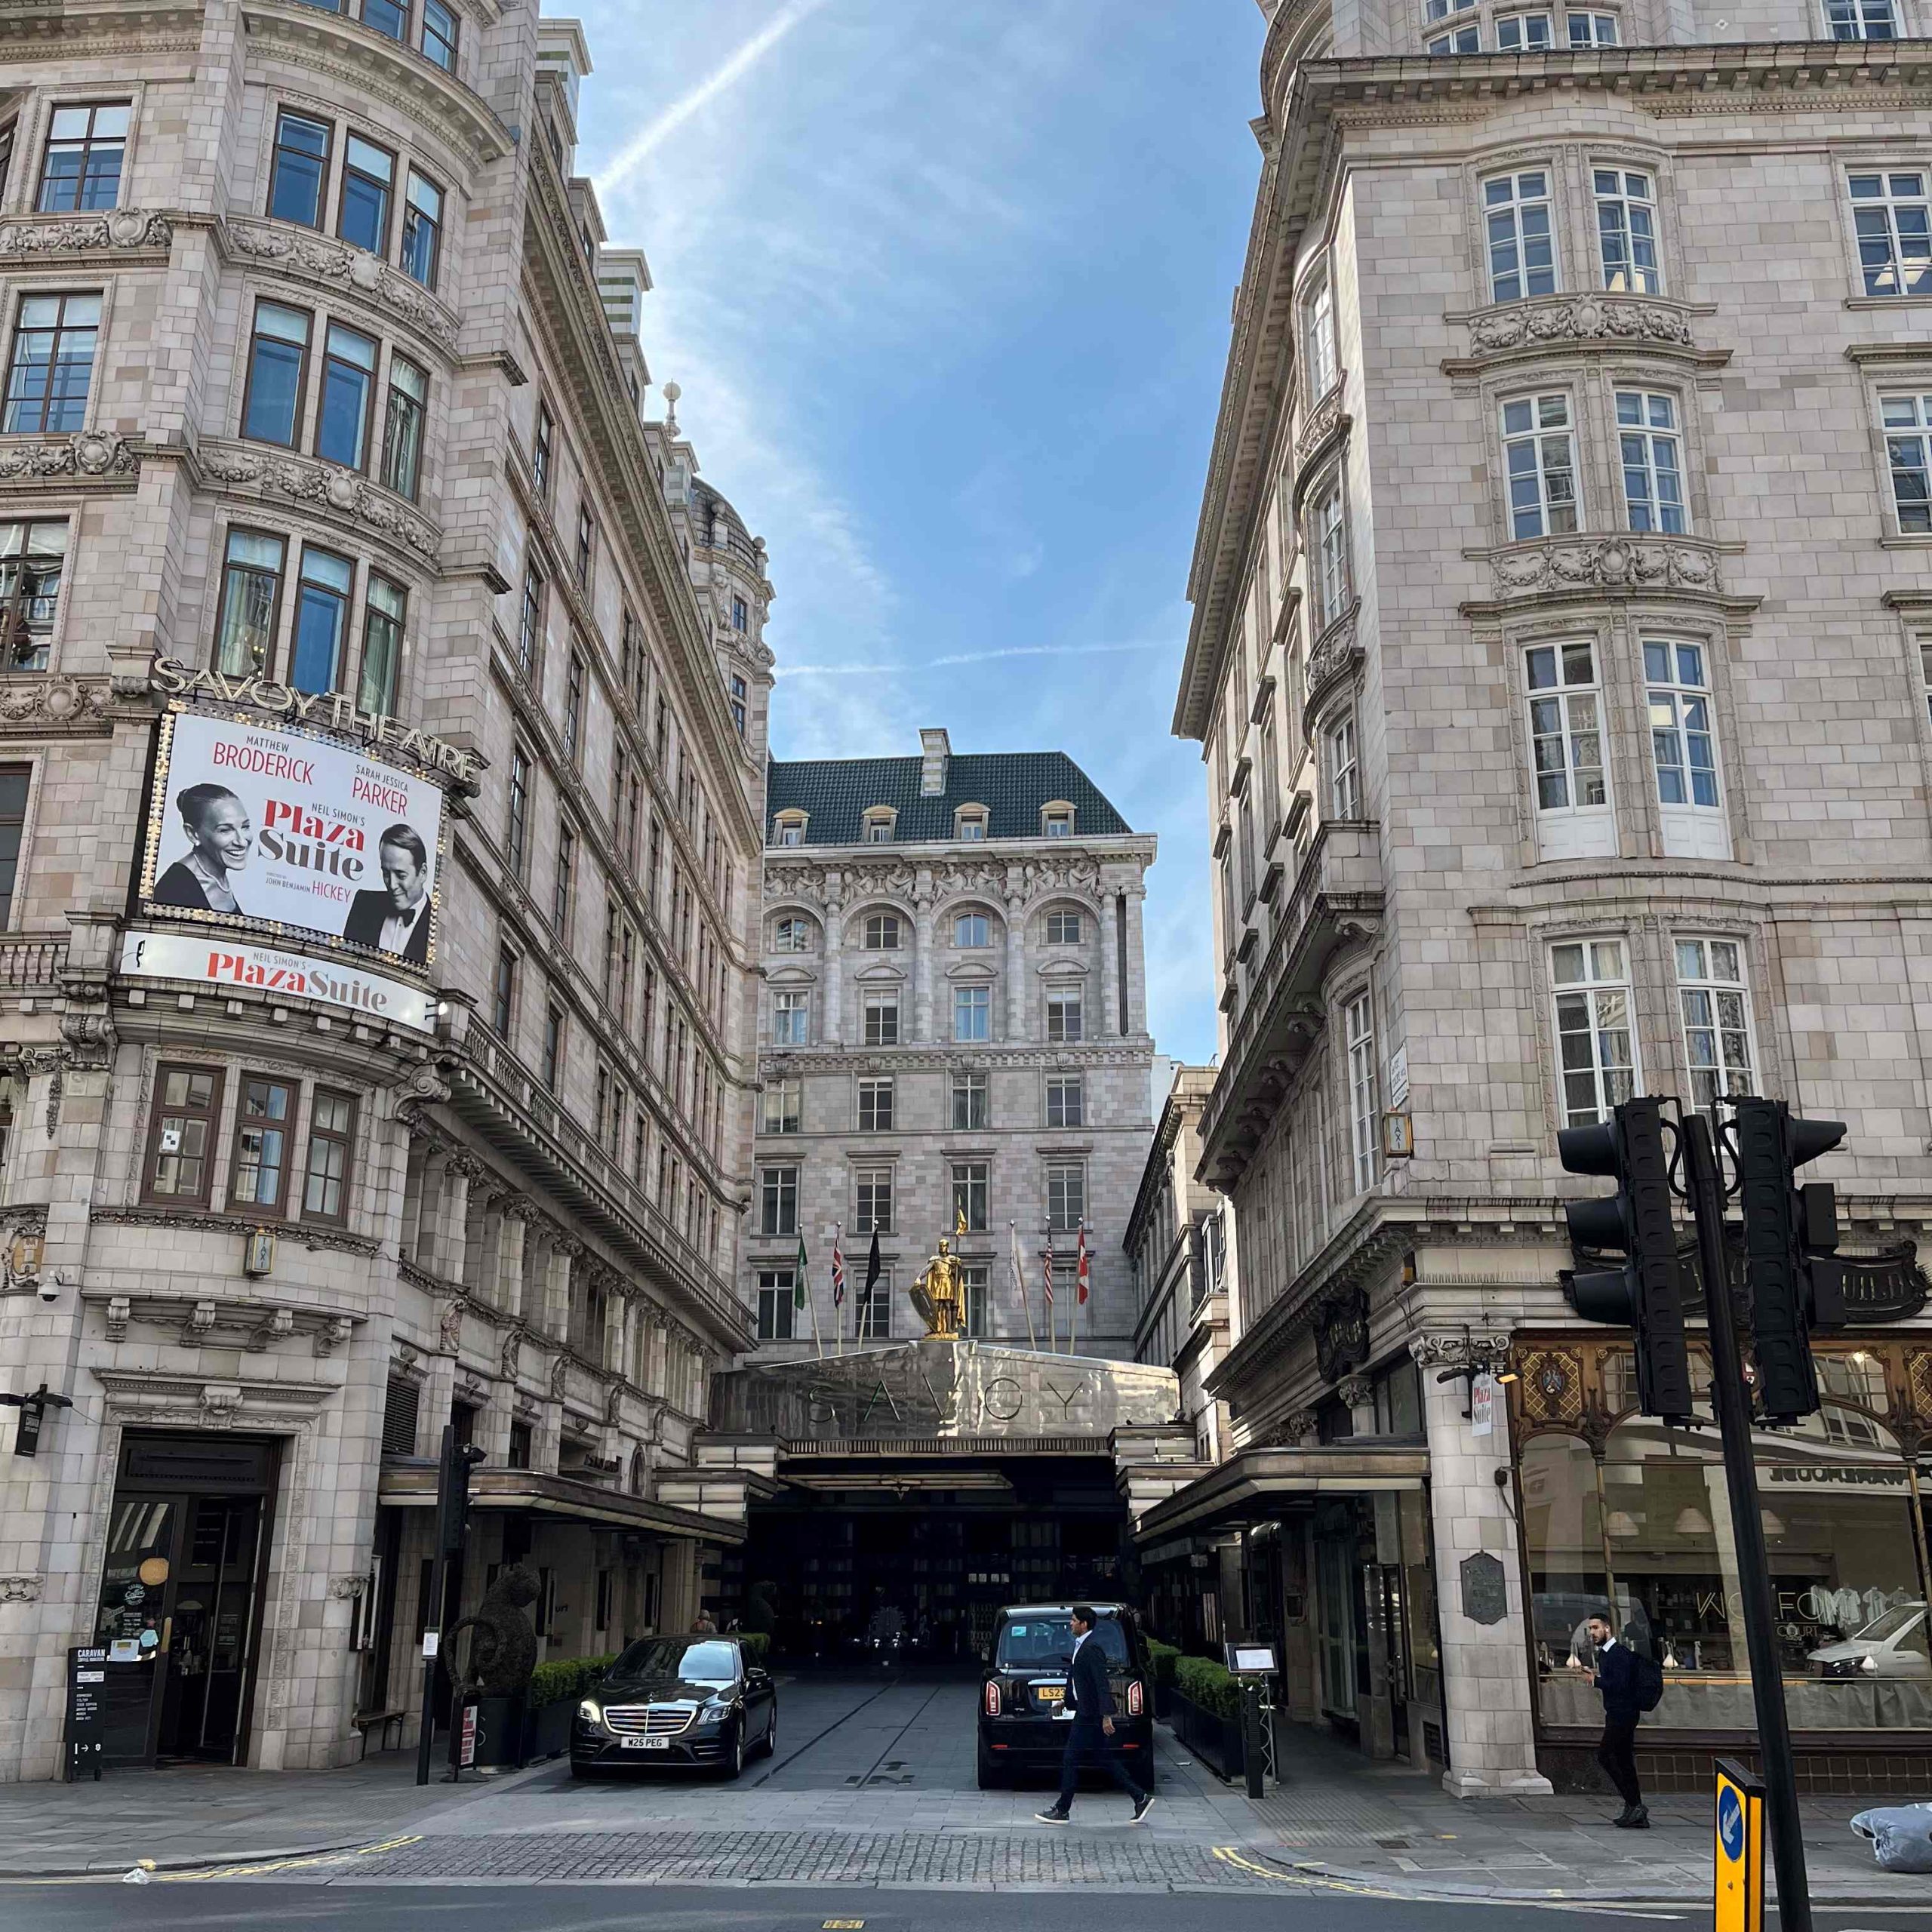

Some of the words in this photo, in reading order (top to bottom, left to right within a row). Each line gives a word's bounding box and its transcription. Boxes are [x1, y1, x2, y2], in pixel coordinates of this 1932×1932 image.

[151, 656, 319, 716] SAVOY
[324, 690, 481, 783] THEATRE
[246, 735, 290, 752] MATTHEW
[213, 741, 315, 786] BRODERICK
[355, 764, 381, 782] SARAH
[382, 772, 408, 792] JESSICA
[352, 776, 408, 816] PARKER
[261, 798, 365, 852] Plaza
[312, 802, 330, 817] NEIL
[332, 808, 365, 827] SIMON'S
[257, 829, 365, 881] Suite
[266, 877, 281, 886] JOHN
[281, 880, 311, 894] BENJAMIN
[312, 880, 352, 903] HICKEY
[253, 952, 272, 964] NEIL
[273, 955, 306, 970] SIMON'S
[207, 952, 306, 993] Plaza
[308, 969, 388, 1012] Suite
[809, 1372, 1084, 1423] SAVOY
[1474, 1386, 1491, 1404] Plaza
[1474, 1404, 1491, 1425] Suite
[78, 1648, 106, 1658] CARAVAN
[645, 1738, 663, 1747] PEG
